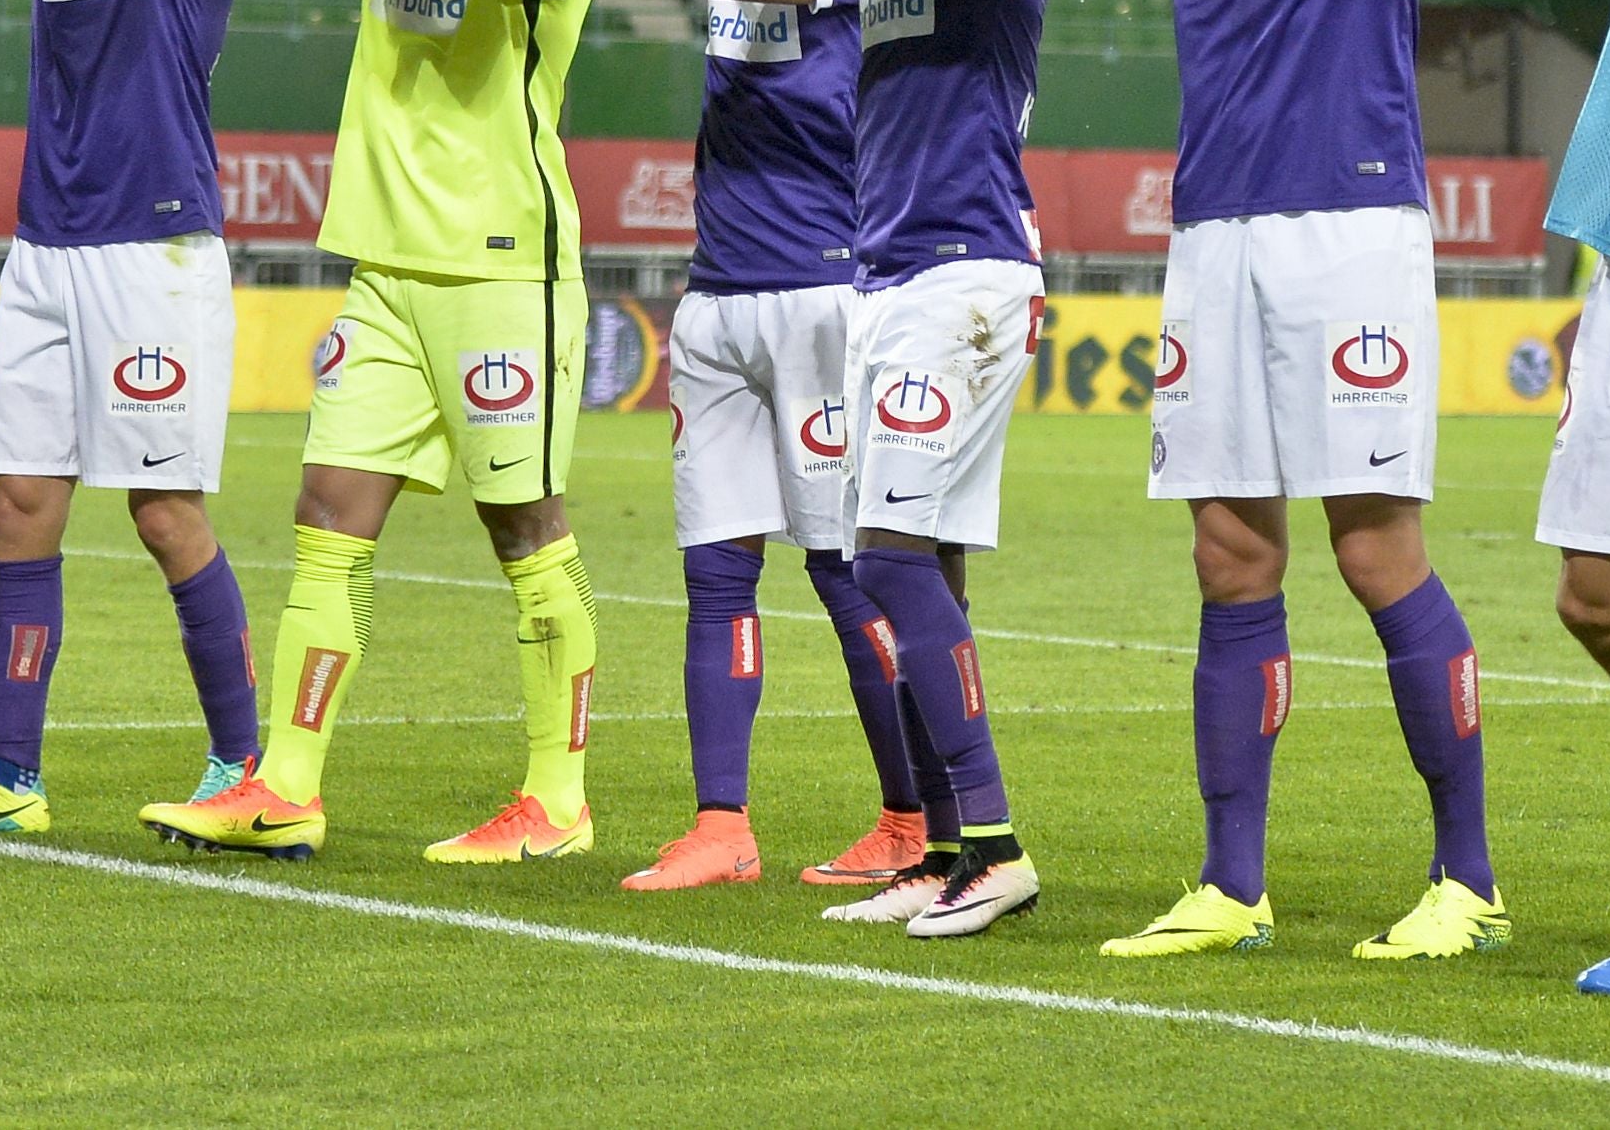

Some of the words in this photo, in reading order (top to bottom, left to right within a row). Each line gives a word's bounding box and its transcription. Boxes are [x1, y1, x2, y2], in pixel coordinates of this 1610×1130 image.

[1331, 391, 1408, 405] HARREITHER
[111, 401, 186, 413] HARREITHER
[467, 411, 535, 424] HARREITHER
[871, 432, 946, 454] HARREITHER
[304, 653, 338, 725] wienholding
